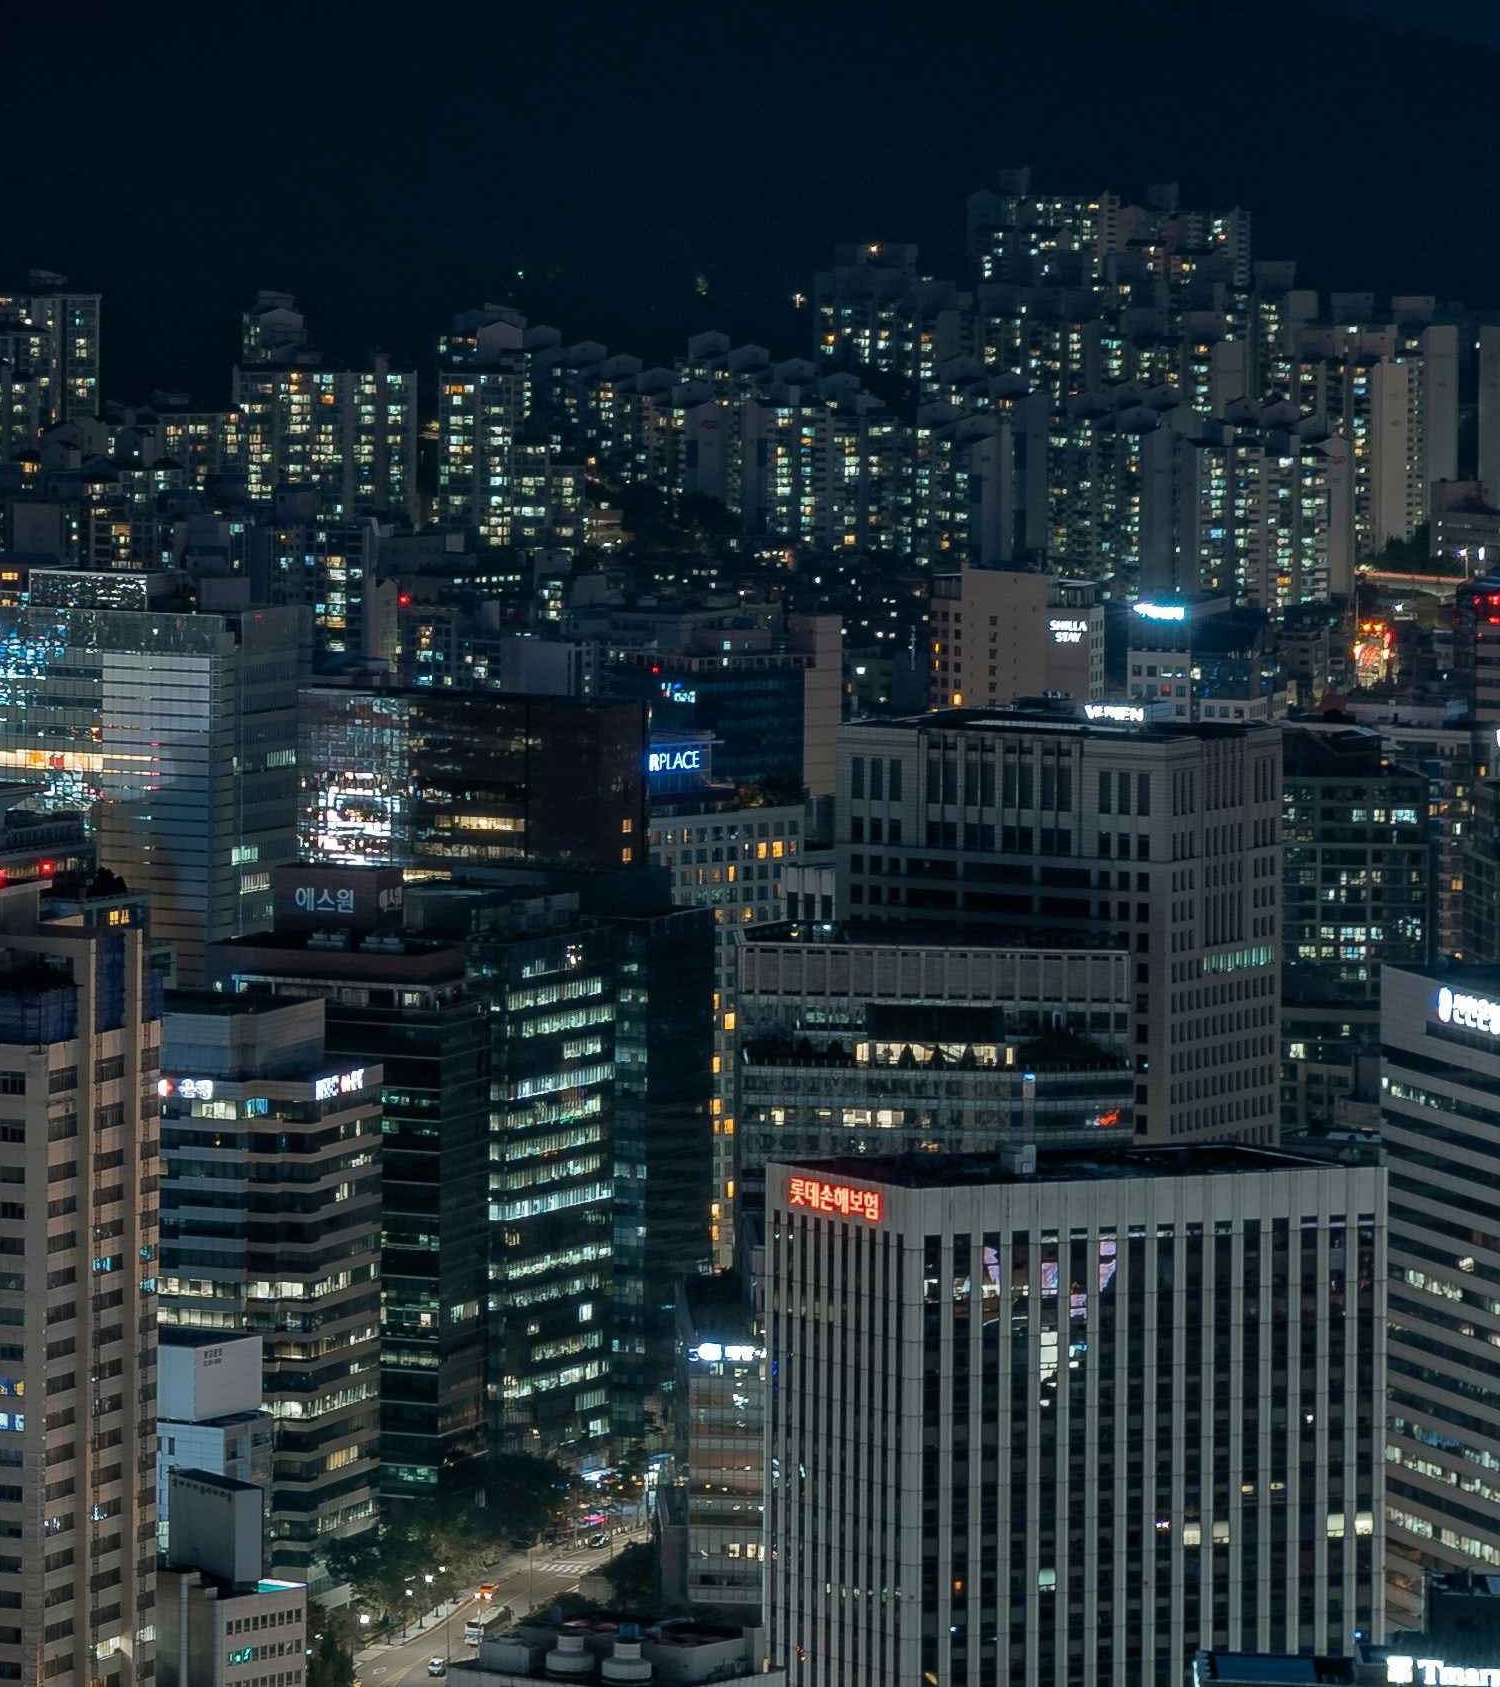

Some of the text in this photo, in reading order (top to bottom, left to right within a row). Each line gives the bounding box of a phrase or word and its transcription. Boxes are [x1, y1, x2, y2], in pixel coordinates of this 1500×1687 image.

[1050, 620, 1088, 632] SHILLA
[1055, 631, 1082, 643] STAY
[295, 887, 354, 914] 에스원
[789, 1177, 880, 1221] 롯데손해보험
